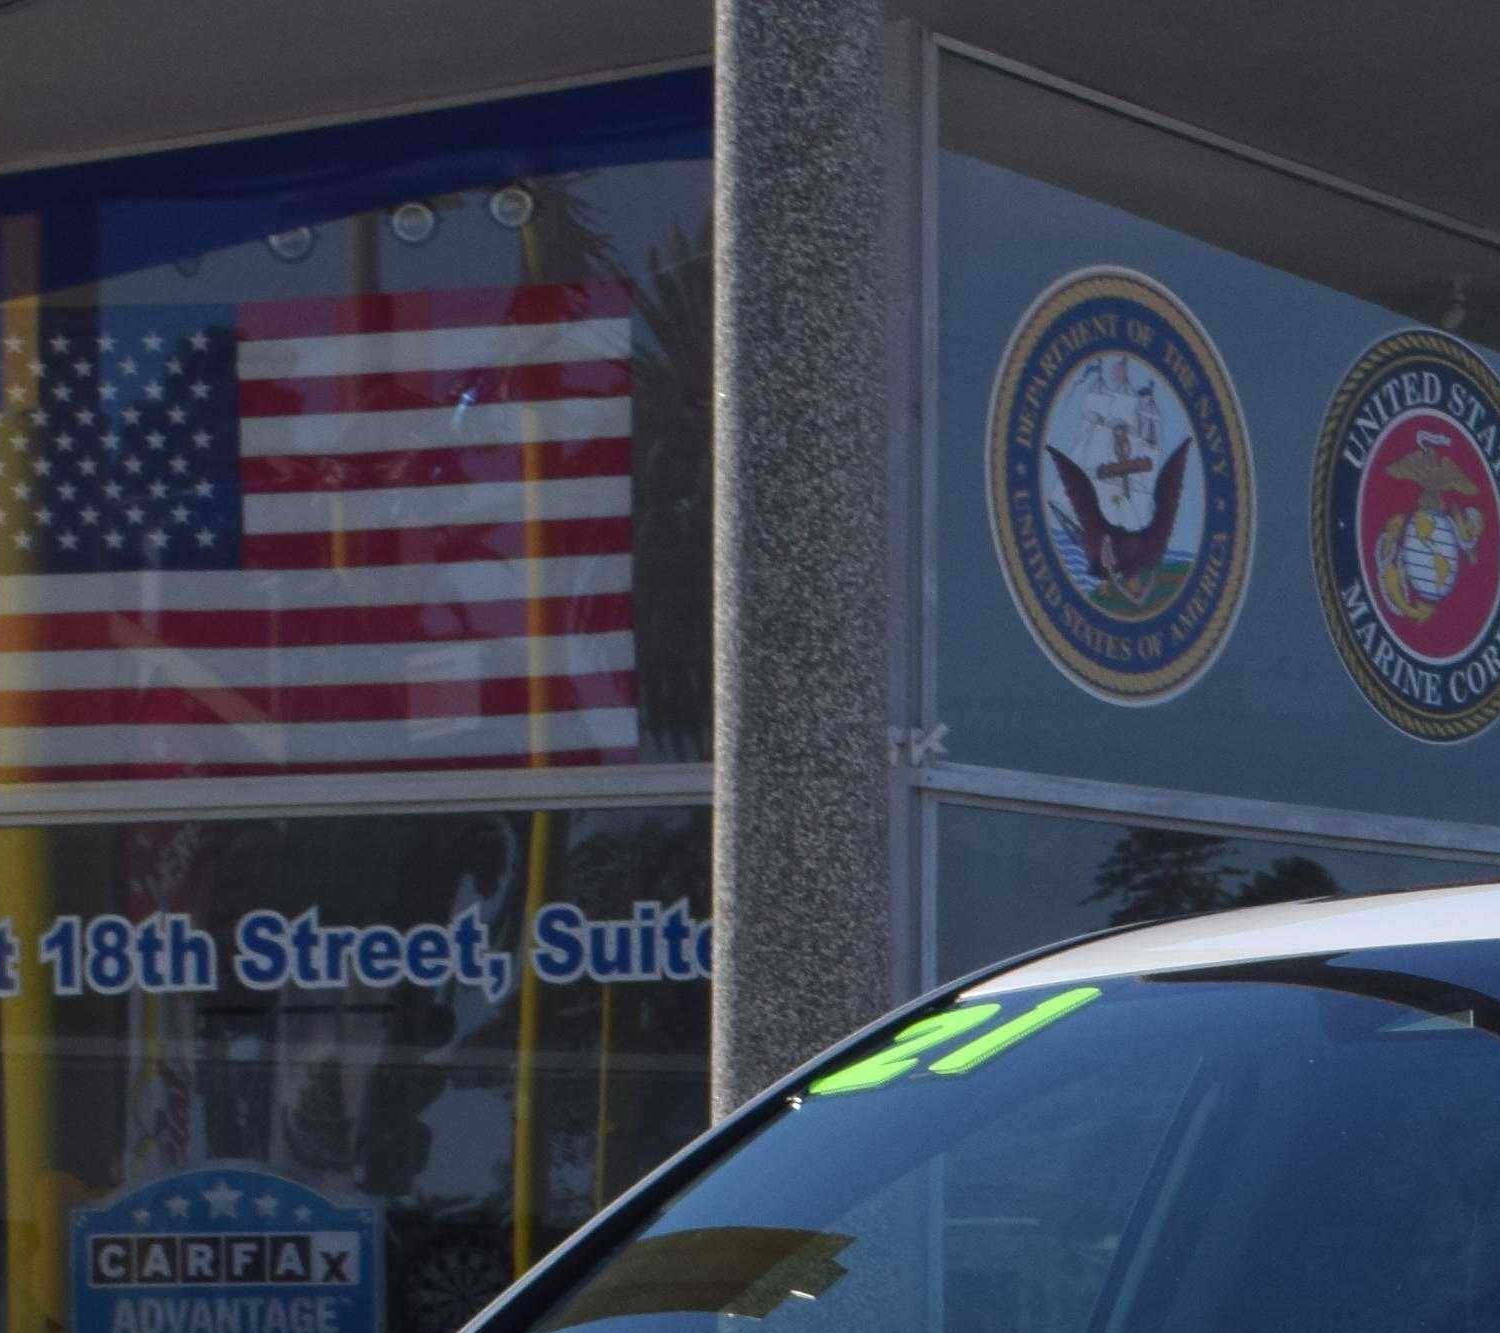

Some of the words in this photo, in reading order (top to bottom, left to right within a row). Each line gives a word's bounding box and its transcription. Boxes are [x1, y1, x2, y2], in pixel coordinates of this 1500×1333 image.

[1342, 370, 1443, 471] UNITED
[1340, 577, 1444, 706] MARINE
[39, 911, 219, 996] 18th
[233, 904, 514, 1003] Street,
[96, 1235, 352, 1285] CARFAX
